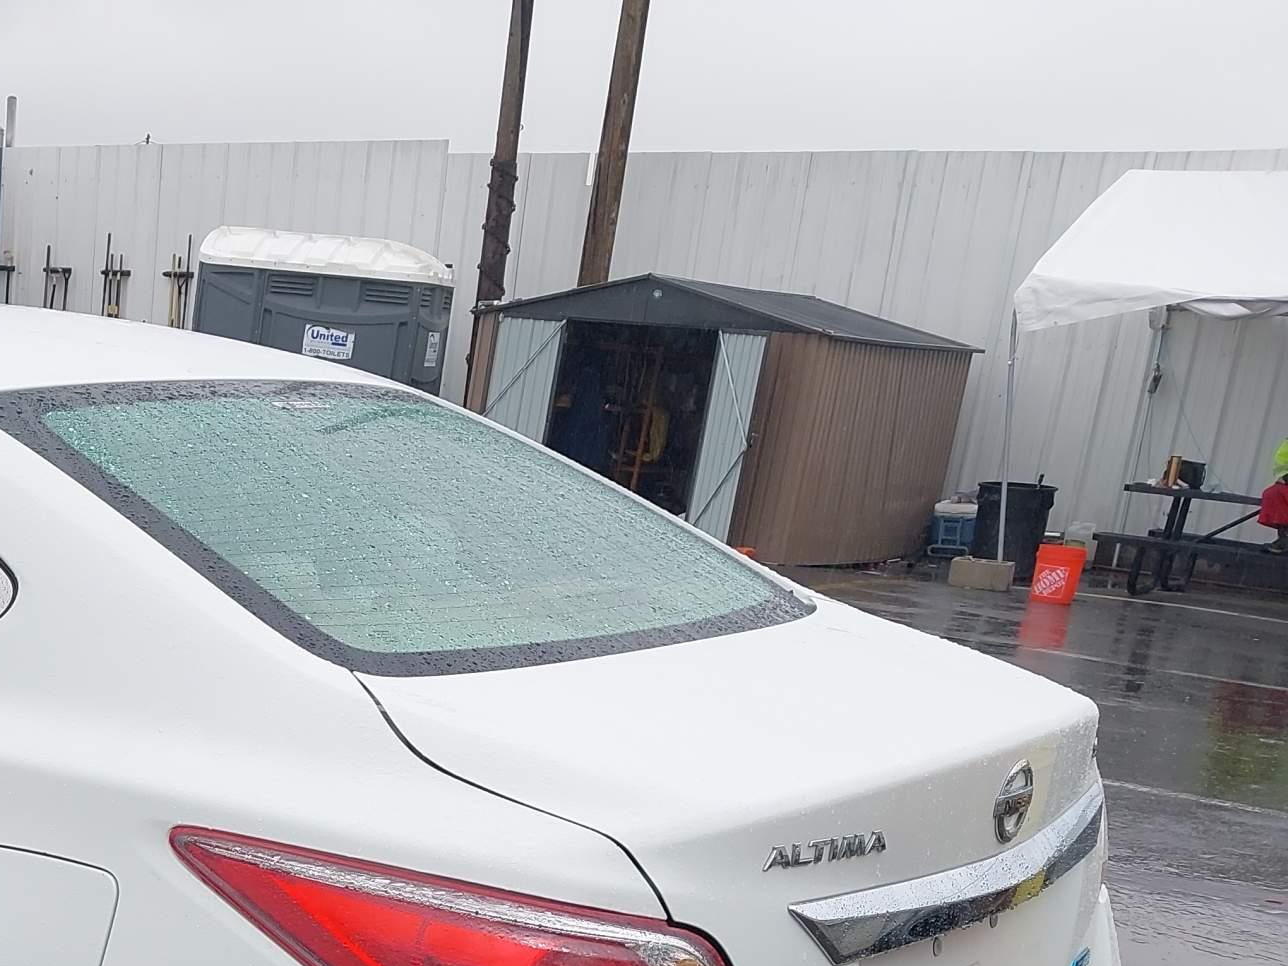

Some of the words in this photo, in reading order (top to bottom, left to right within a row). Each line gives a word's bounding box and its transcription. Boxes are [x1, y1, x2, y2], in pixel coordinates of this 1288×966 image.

[311, 329, 348, 343] United
[1034, 569, 1065, 594] HOME
[762, 829, 887, 872] ALTIMA
